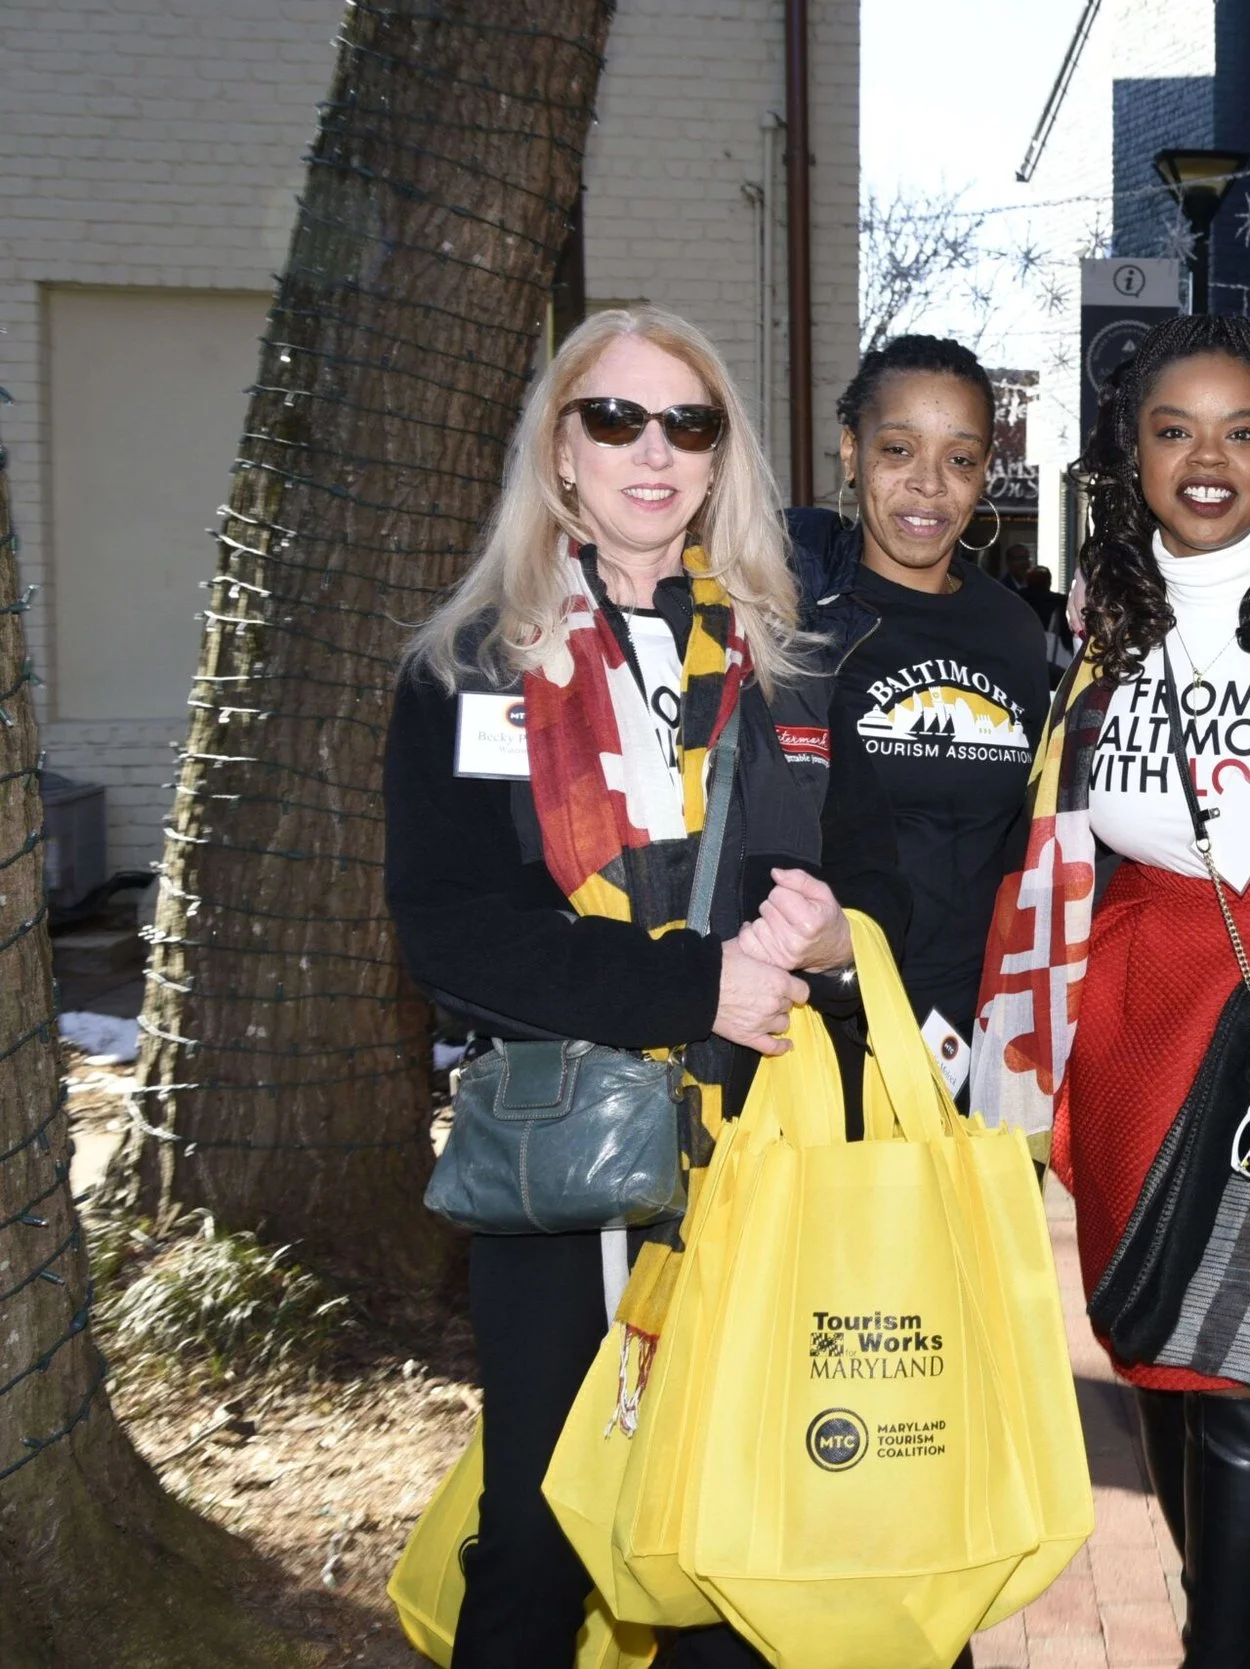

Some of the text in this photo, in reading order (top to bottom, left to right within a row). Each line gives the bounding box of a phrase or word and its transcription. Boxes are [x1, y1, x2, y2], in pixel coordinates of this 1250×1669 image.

[867, 659, 1025, 719] BALTIMORE
[510, 712, 527, 720] MT
[478, 730, 512, 746] Becky
[776, 729, 829, 746] termark
[864, 738, 1032, 764] OURISM ASSOCIATION
[813, 1311, 922, 1331] Tourism
[858, 1331, 943, 1352] Works
[810, 1355, 944, 1380] MARYLAND
[877, 1420, 946, 1434] MARYLAND
[820, 1435, 856, 1450] MTC
[877, 1434, 934, 1445] TOURISM
[877, 1445, 946, 1458] COALITION
